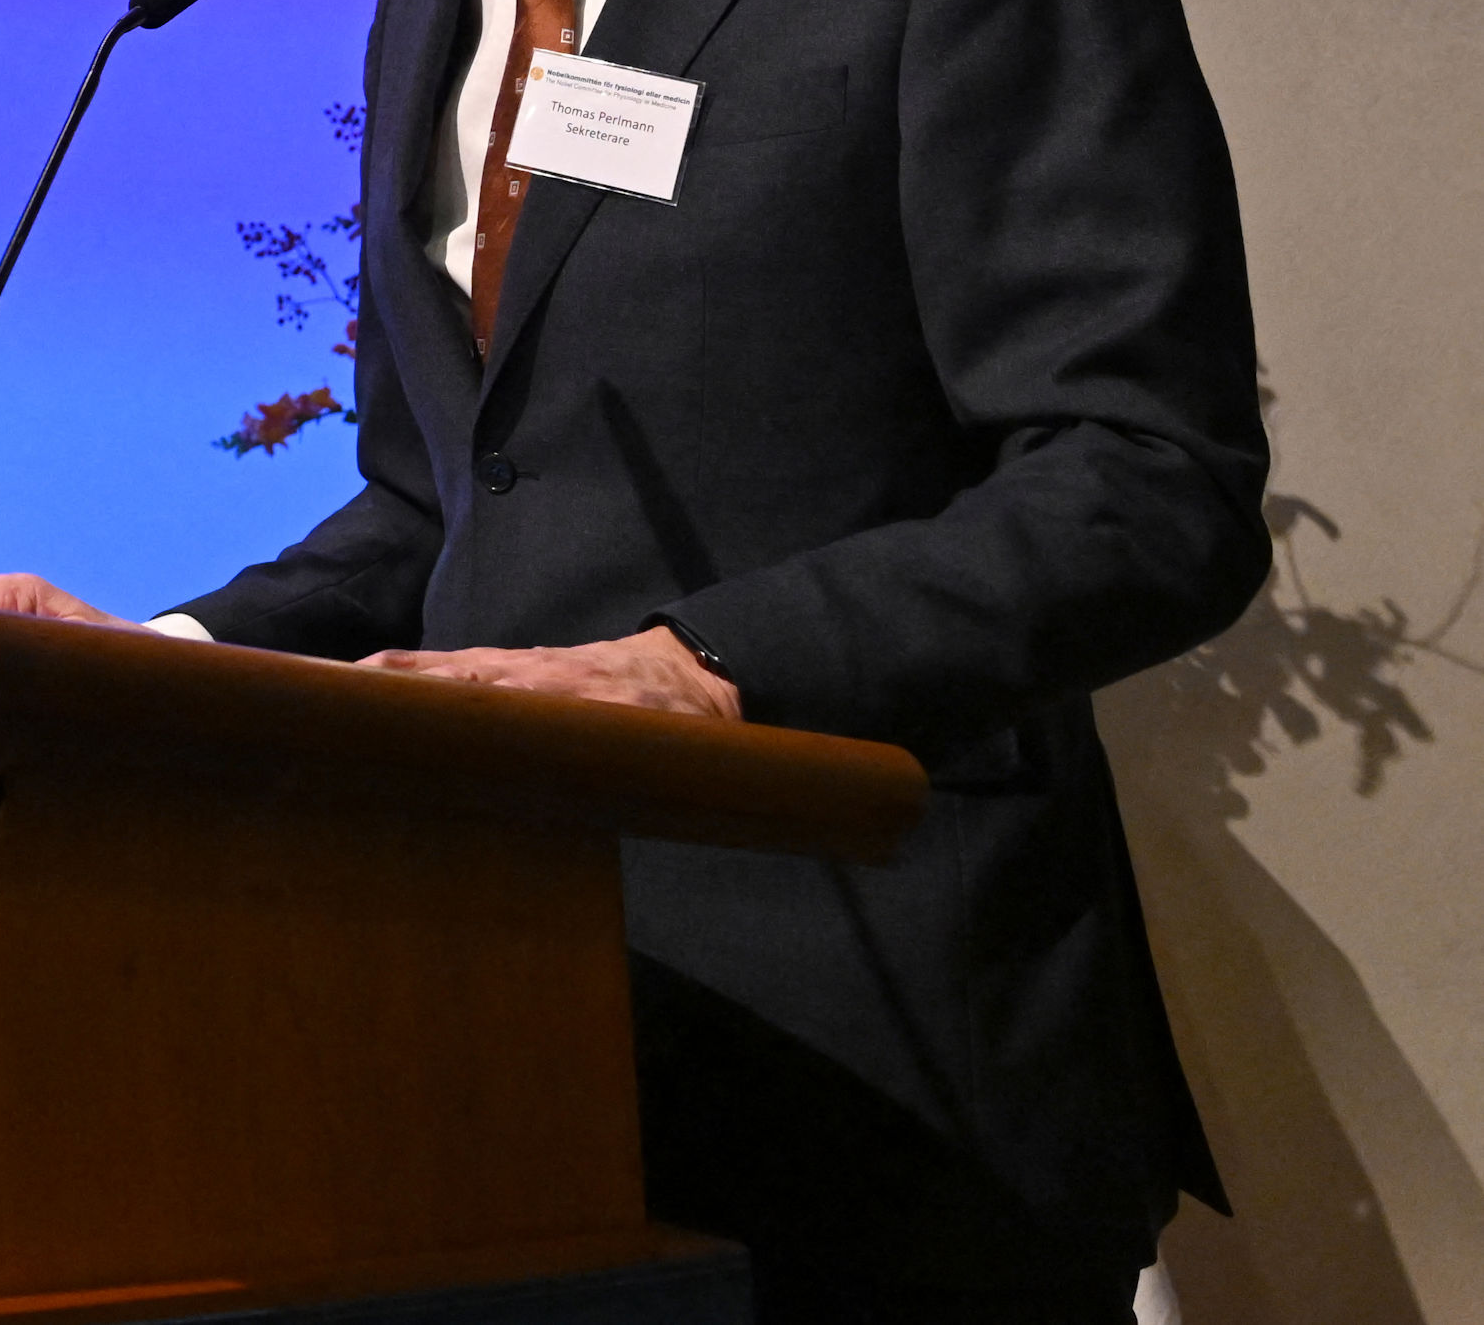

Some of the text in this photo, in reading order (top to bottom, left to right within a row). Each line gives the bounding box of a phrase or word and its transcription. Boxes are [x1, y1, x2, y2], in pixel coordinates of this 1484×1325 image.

[603, 81, 613, 89] för
[614, 83, 644, 96] fysiologi
[646, 91, 661, 99] eller
[663, 94, 691, 106] medicin
[550, 100, 656, 134] Thomas Perlmann
[565, 122, 631, 147] Sekreterare
